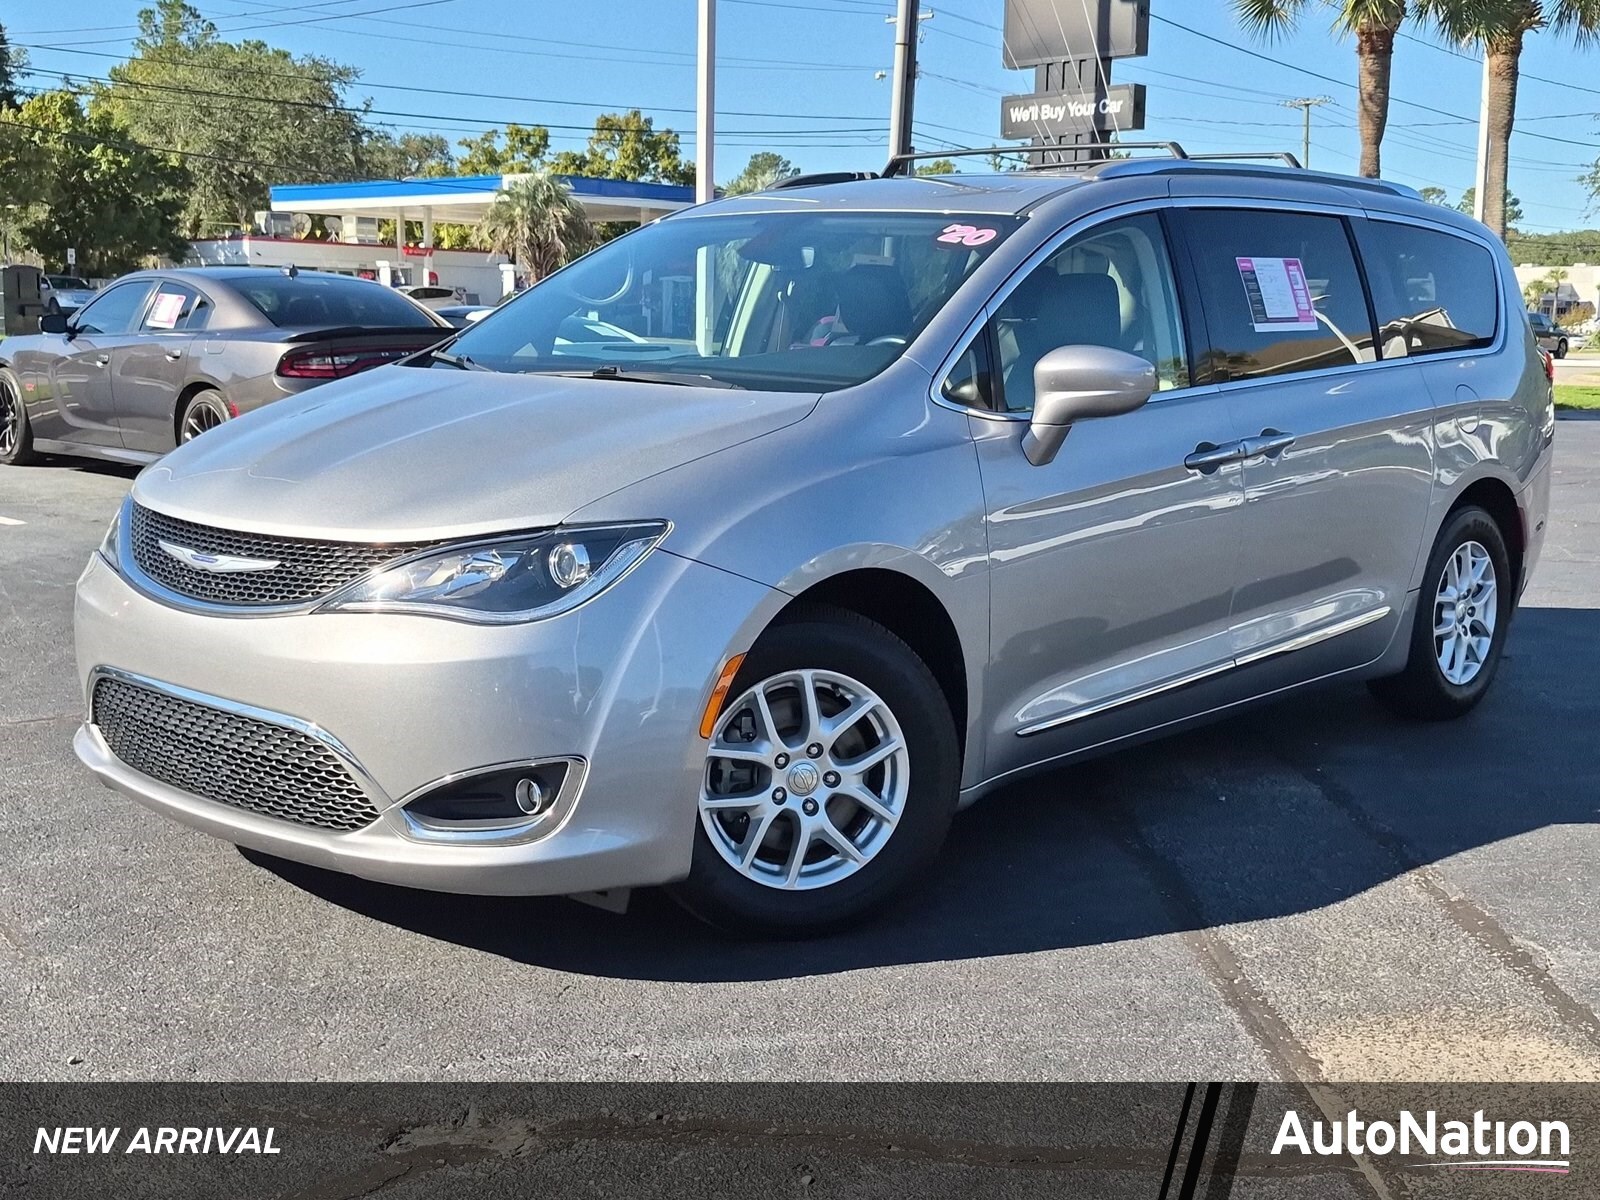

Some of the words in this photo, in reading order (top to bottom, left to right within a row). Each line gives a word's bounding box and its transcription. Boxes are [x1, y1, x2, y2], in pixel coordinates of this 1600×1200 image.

[1010, 104, 1038, 123] We'll
[1040, 104, 1066, 122] Buy
[1067, 101, 1096, 117] Your
[1099, 98, 1124, 114] Car
[936, 223, 997, 246] 20
